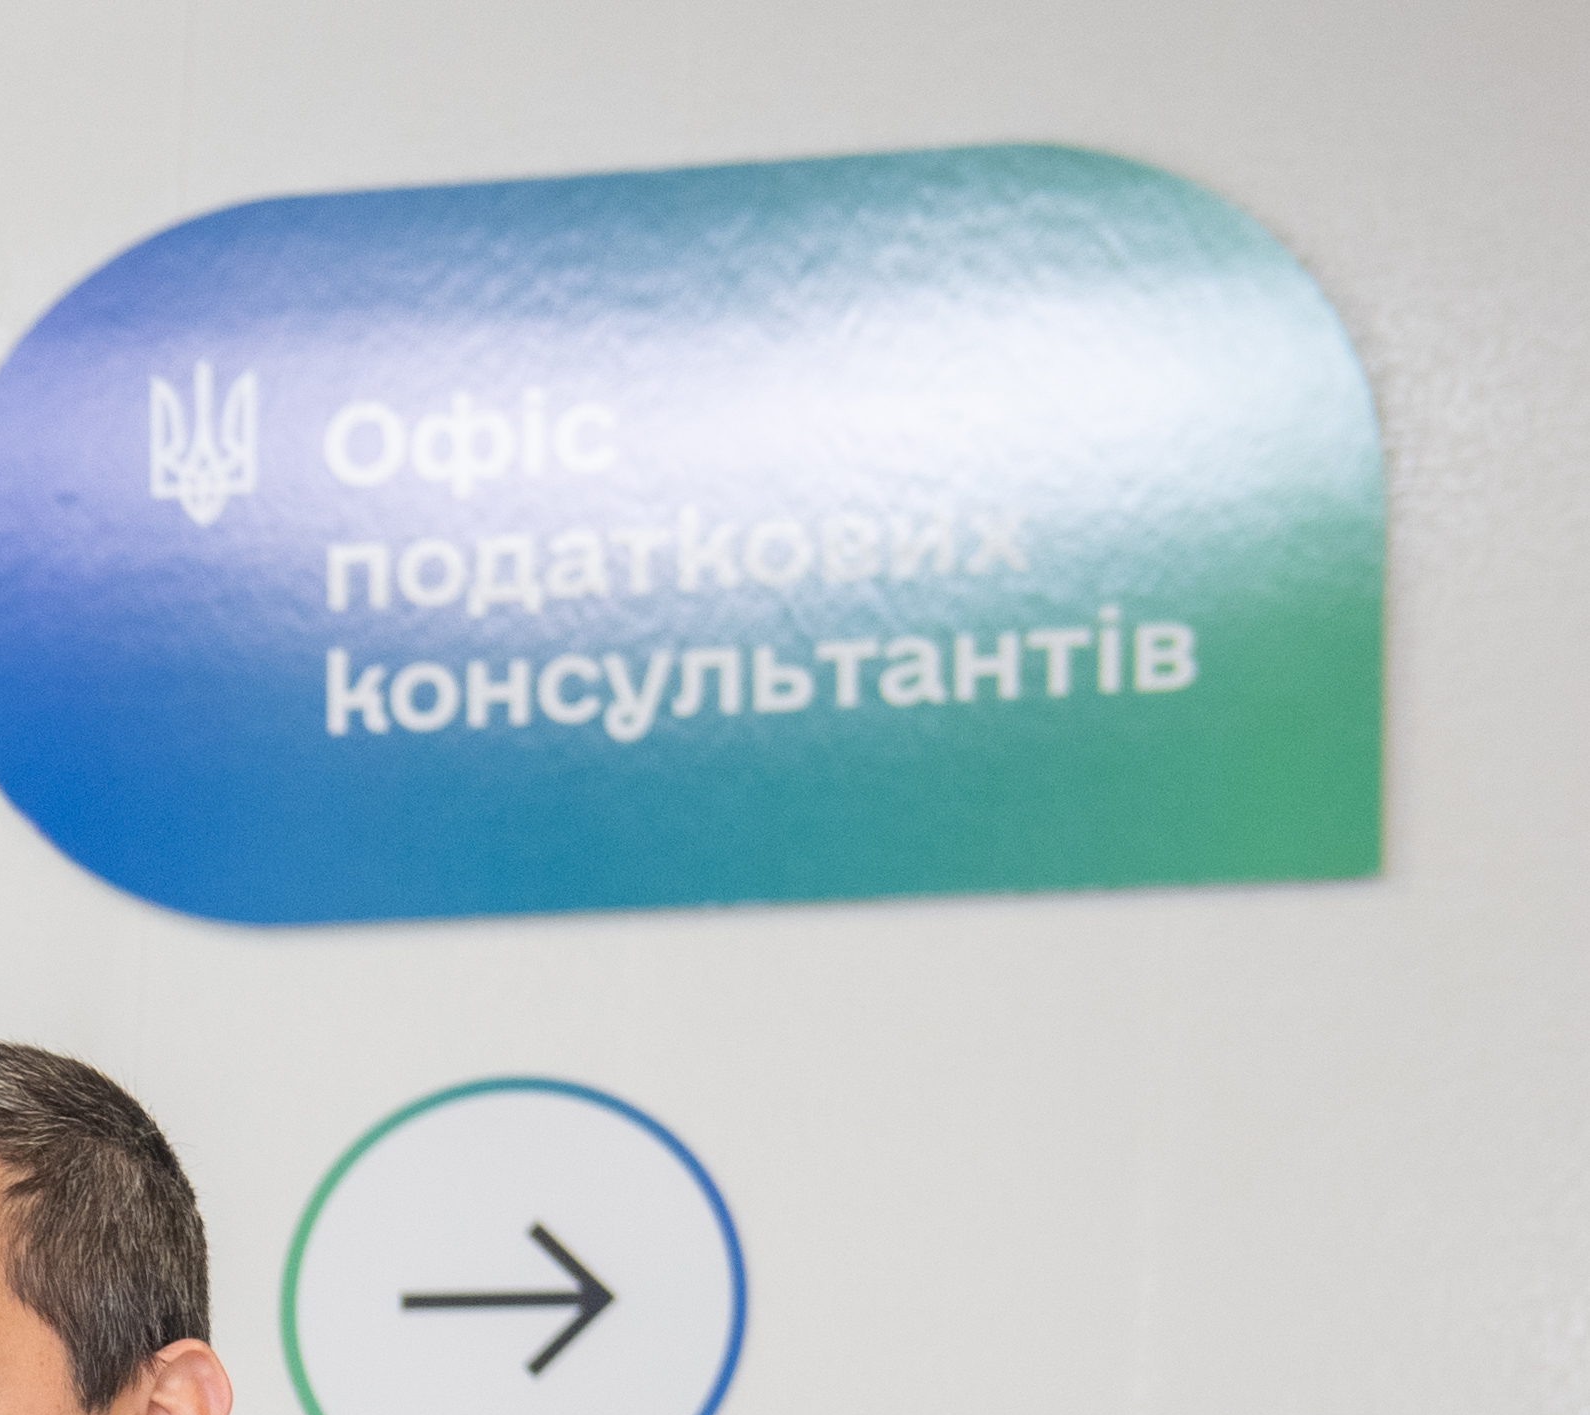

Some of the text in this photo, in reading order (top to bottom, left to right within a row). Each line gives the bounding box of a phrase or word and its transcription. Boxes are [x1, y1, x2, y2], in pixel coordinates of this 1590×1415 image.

[322, 388, 620, 498] Офіс
[326, 504, 1030, 618] податкових
[326, 606, 1198, 742] консультантів
